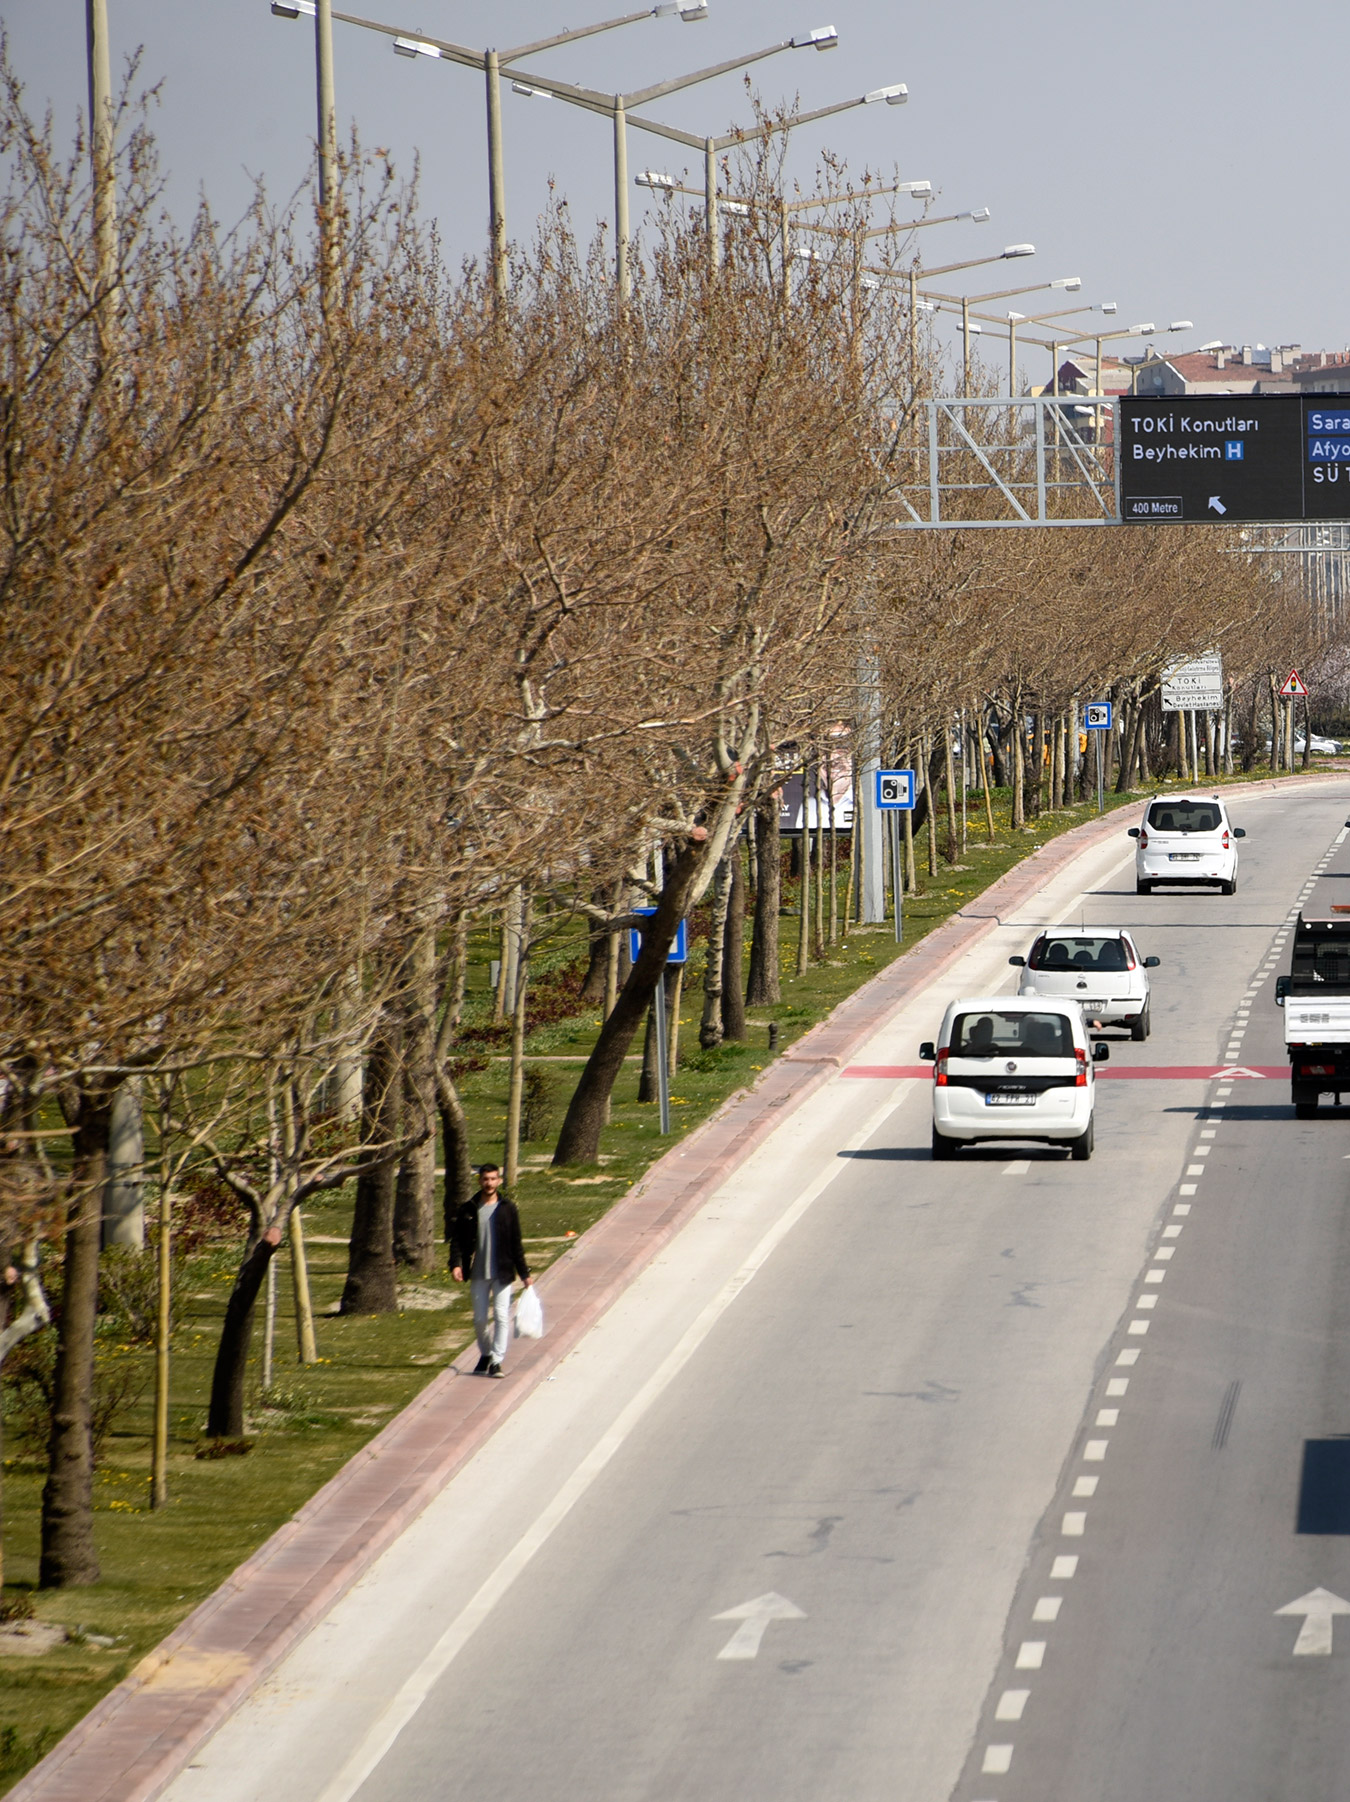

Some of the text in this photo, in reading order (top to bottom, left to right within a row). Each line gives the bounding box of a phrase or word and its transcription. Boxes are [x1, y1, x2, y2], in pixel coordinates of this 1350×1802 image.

[1131, 413, 1259, 433] TOKİ Konutları
[1133, 443, 1222, 463] Beyhekim
[1313, 463, 1339, 483] SÜ
[1132, 502, 1179, 514] 400 Metre
